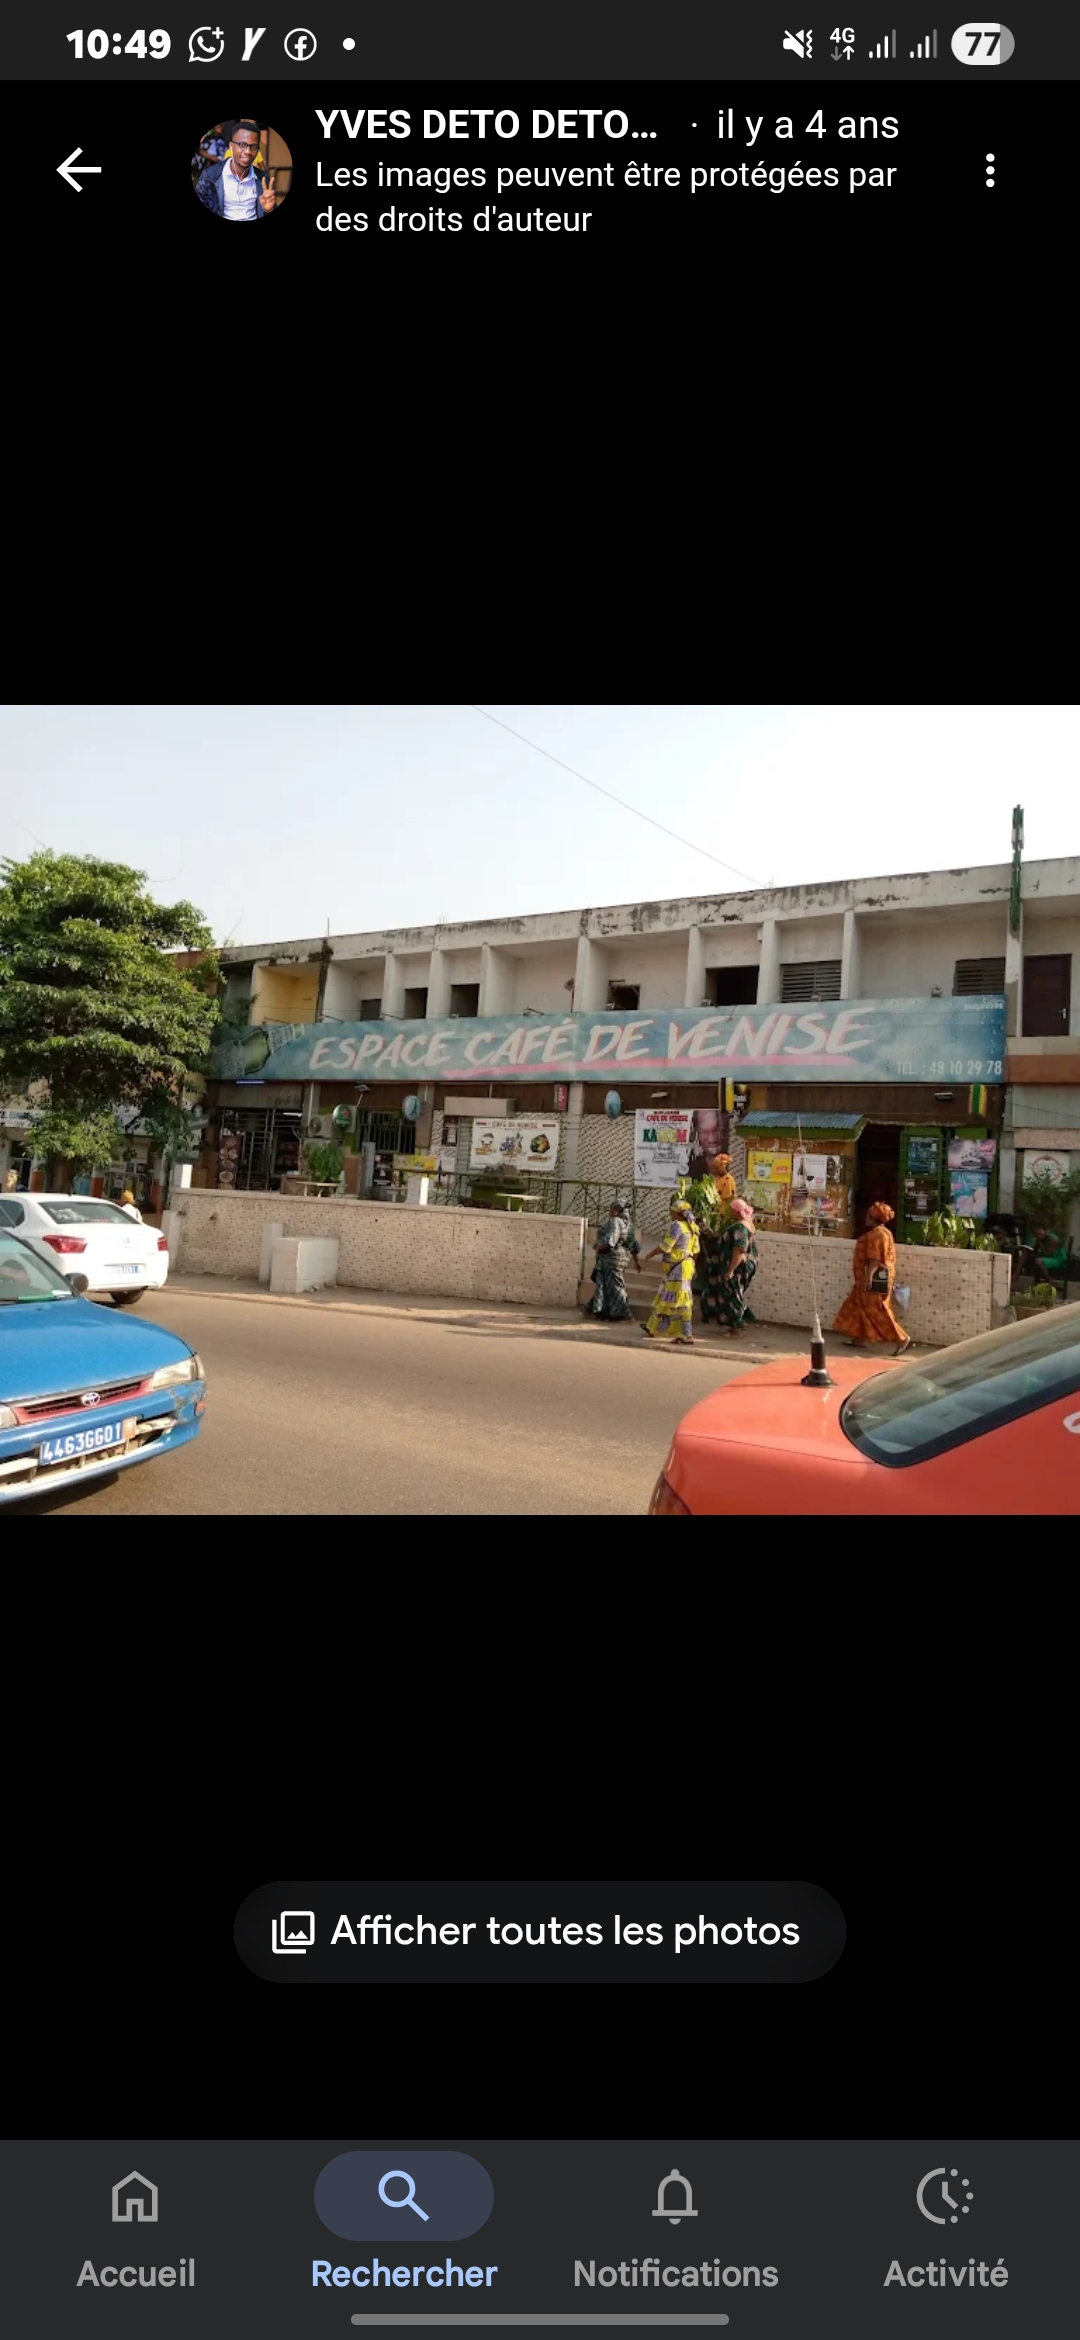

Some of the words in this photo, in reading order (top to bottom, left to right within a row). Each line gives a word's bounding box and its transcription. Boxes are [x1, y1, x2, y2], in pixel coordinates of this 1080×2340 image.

[309, 1030, 456, 1070] ESPACE
[463, 1017, 577, 1065] CAFÉ
[582, 1019, 655, 1062] DE
[668, 1006, 876, 1059] VENISE
[929, 1060, 945, 1076] 48
[966, 1060, 982, 1076] 29
[986, 1060, 1002, 1075] 78
[43, 1421, 123, 1461] 4463GG01
